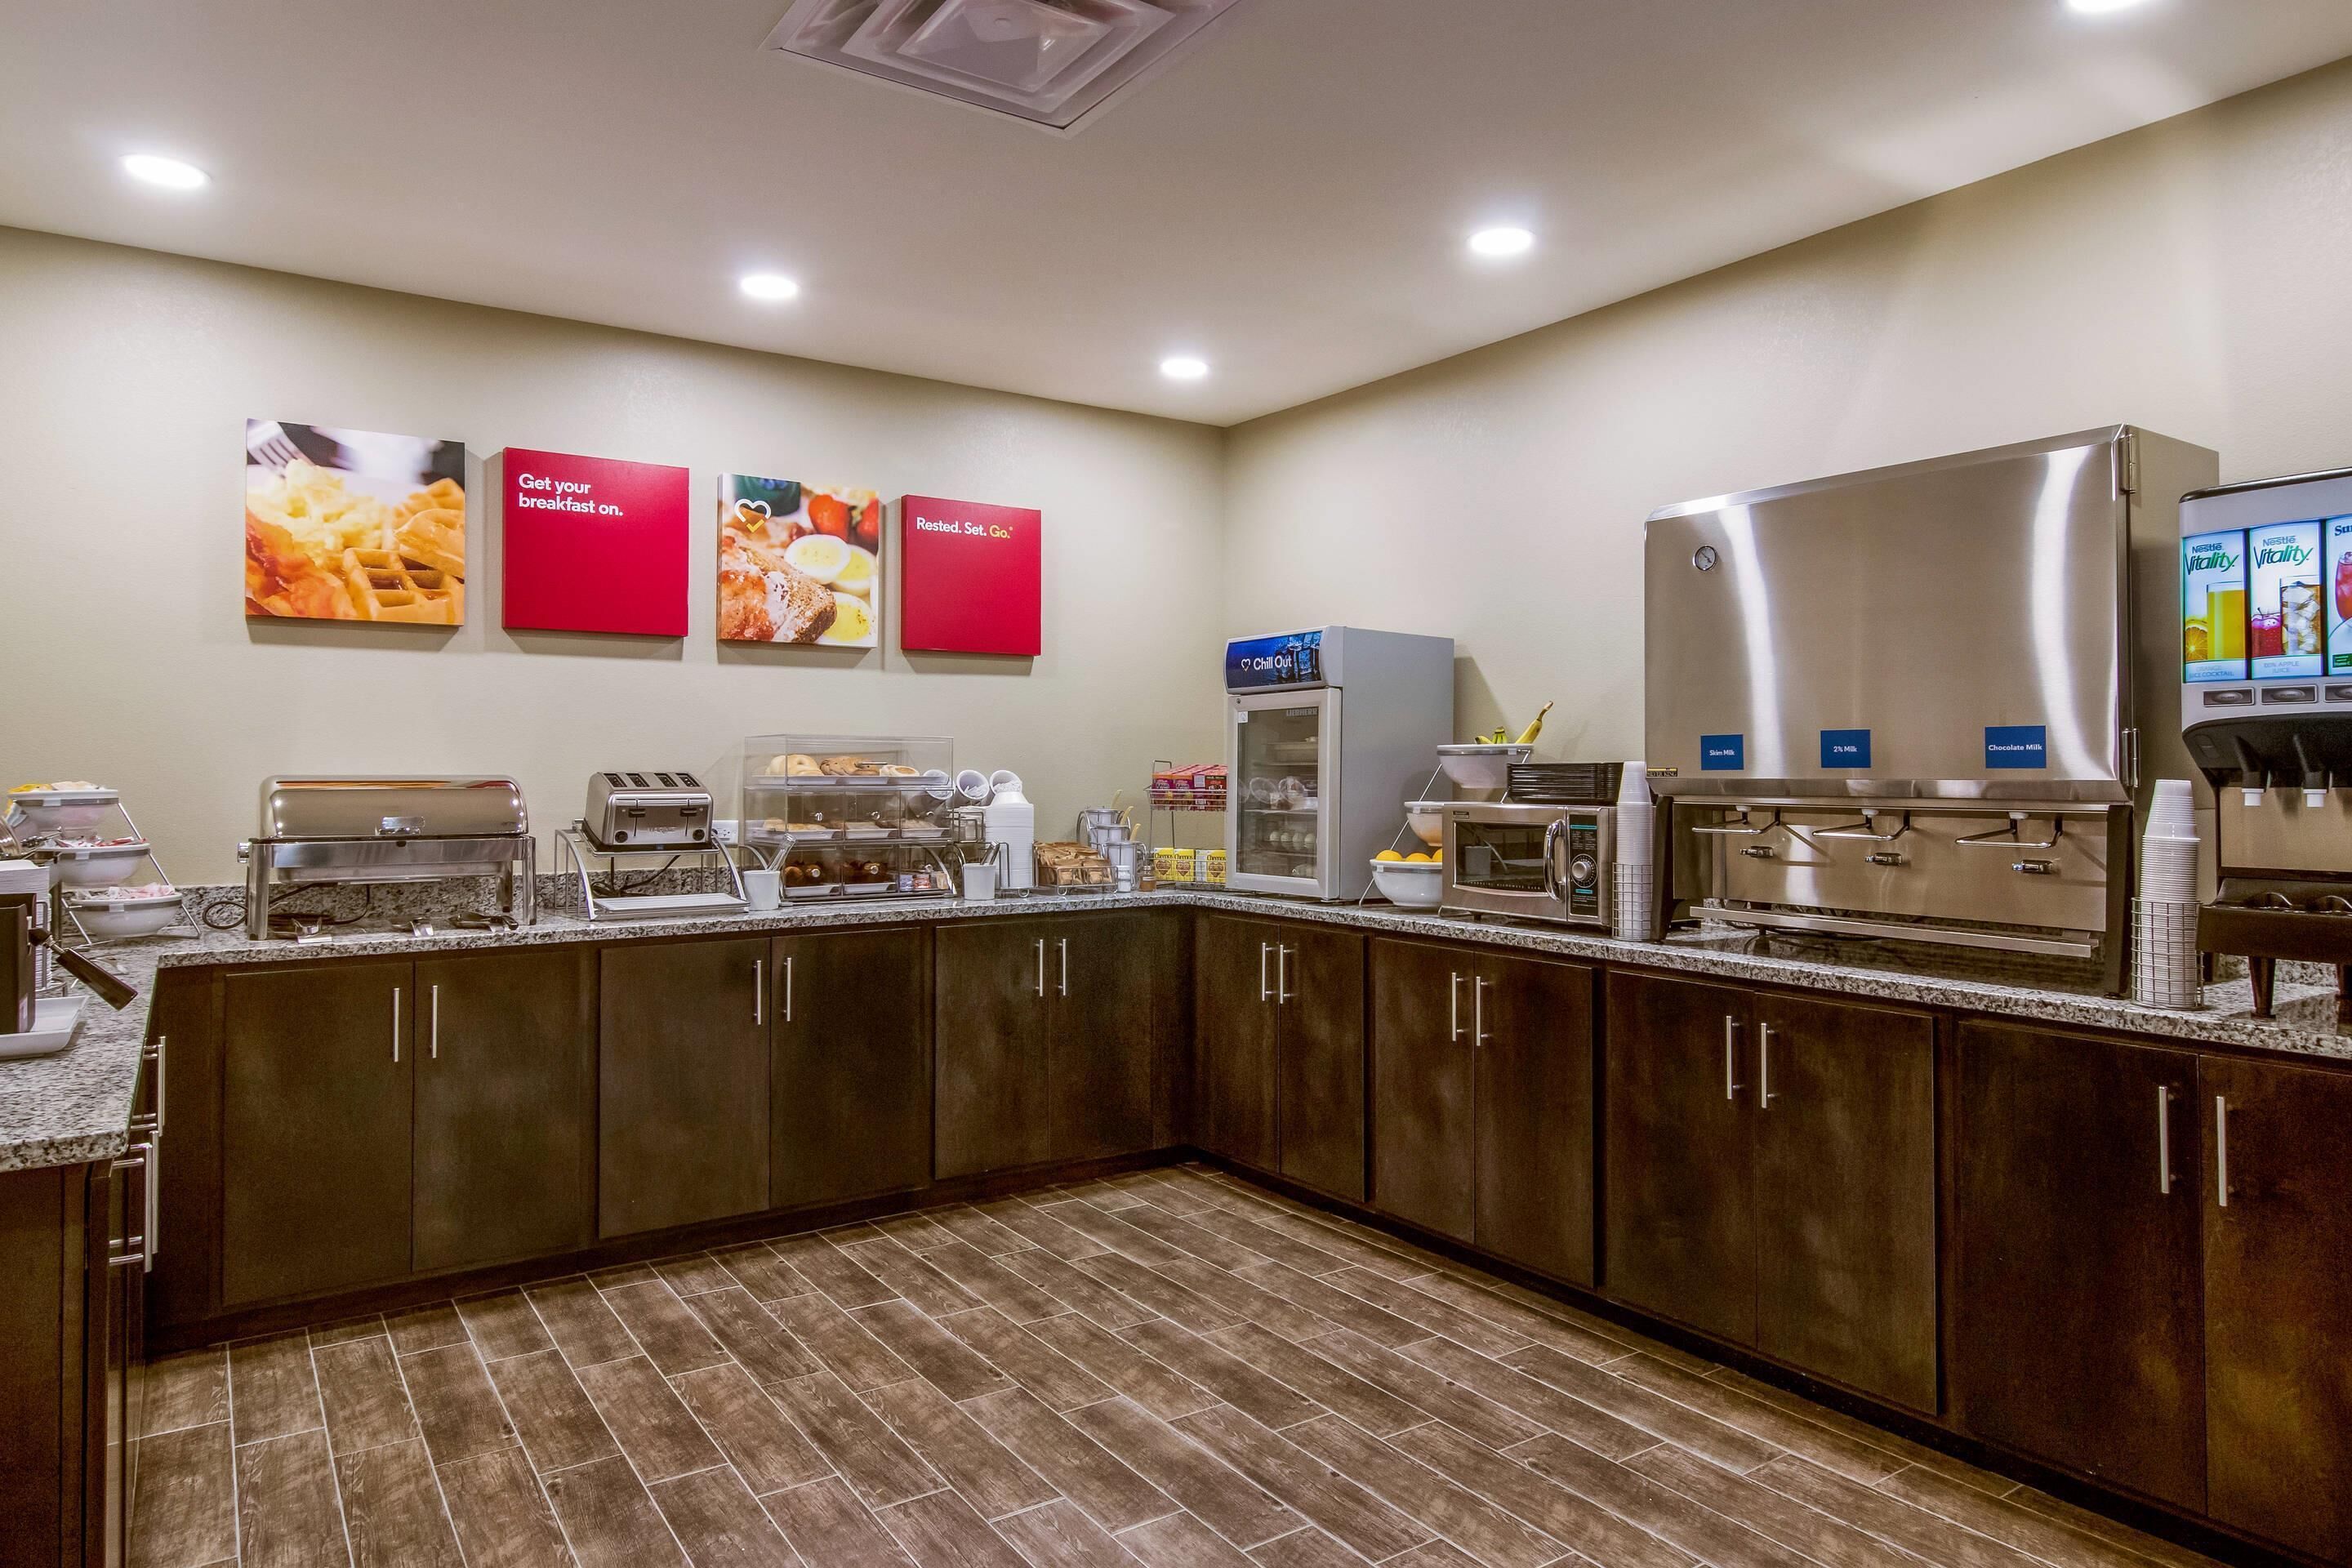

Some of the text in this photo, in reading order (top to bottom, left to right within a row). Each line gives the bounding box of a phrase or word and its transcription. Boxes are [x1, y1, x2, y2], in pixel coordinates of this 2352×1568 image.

[519, 473, 591, 495] Get your
[519, 492, 623, 516] breakfast on.
[916, 517, 962, 533] Rested.
[964, 522, 987, 537] Set.
[2185, 551, 2239, 575] Vitality
[2253, 544, 2314, 569] Vitality
[1253, 655, 1292, 670] Chill Out
